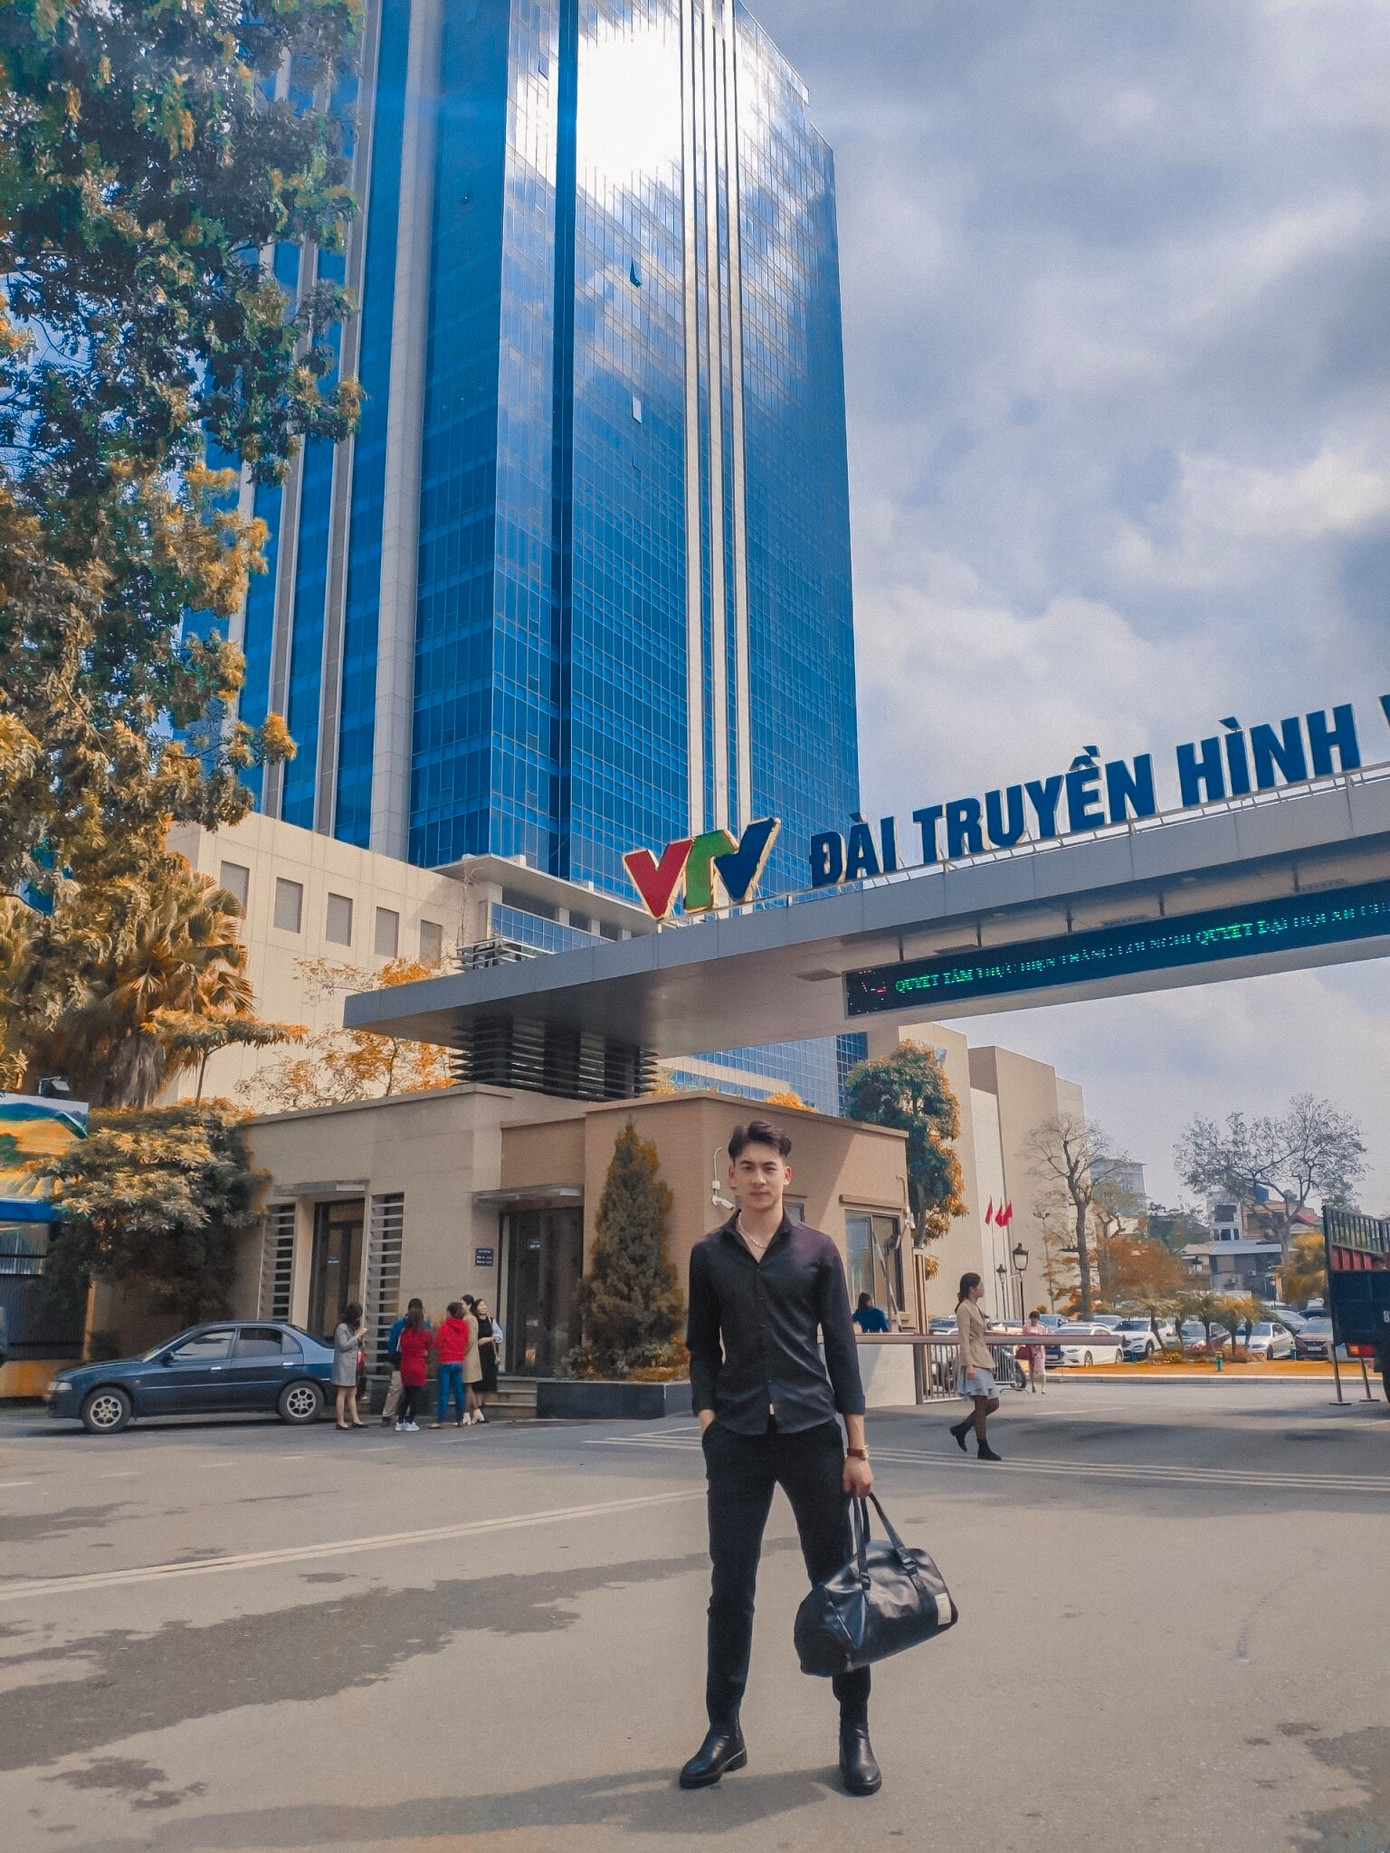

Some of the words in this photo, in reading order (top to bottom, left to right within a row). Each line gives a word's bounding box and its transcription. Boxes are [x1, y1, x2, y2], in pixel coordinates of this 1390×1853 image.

[809, 812, 899, 889] ĐÀI
[912, 744, 1158, 866] TRUYỀN
[1176, 703, 1361, 808] HÌNH
[622, 817, 781, 920] VTV
